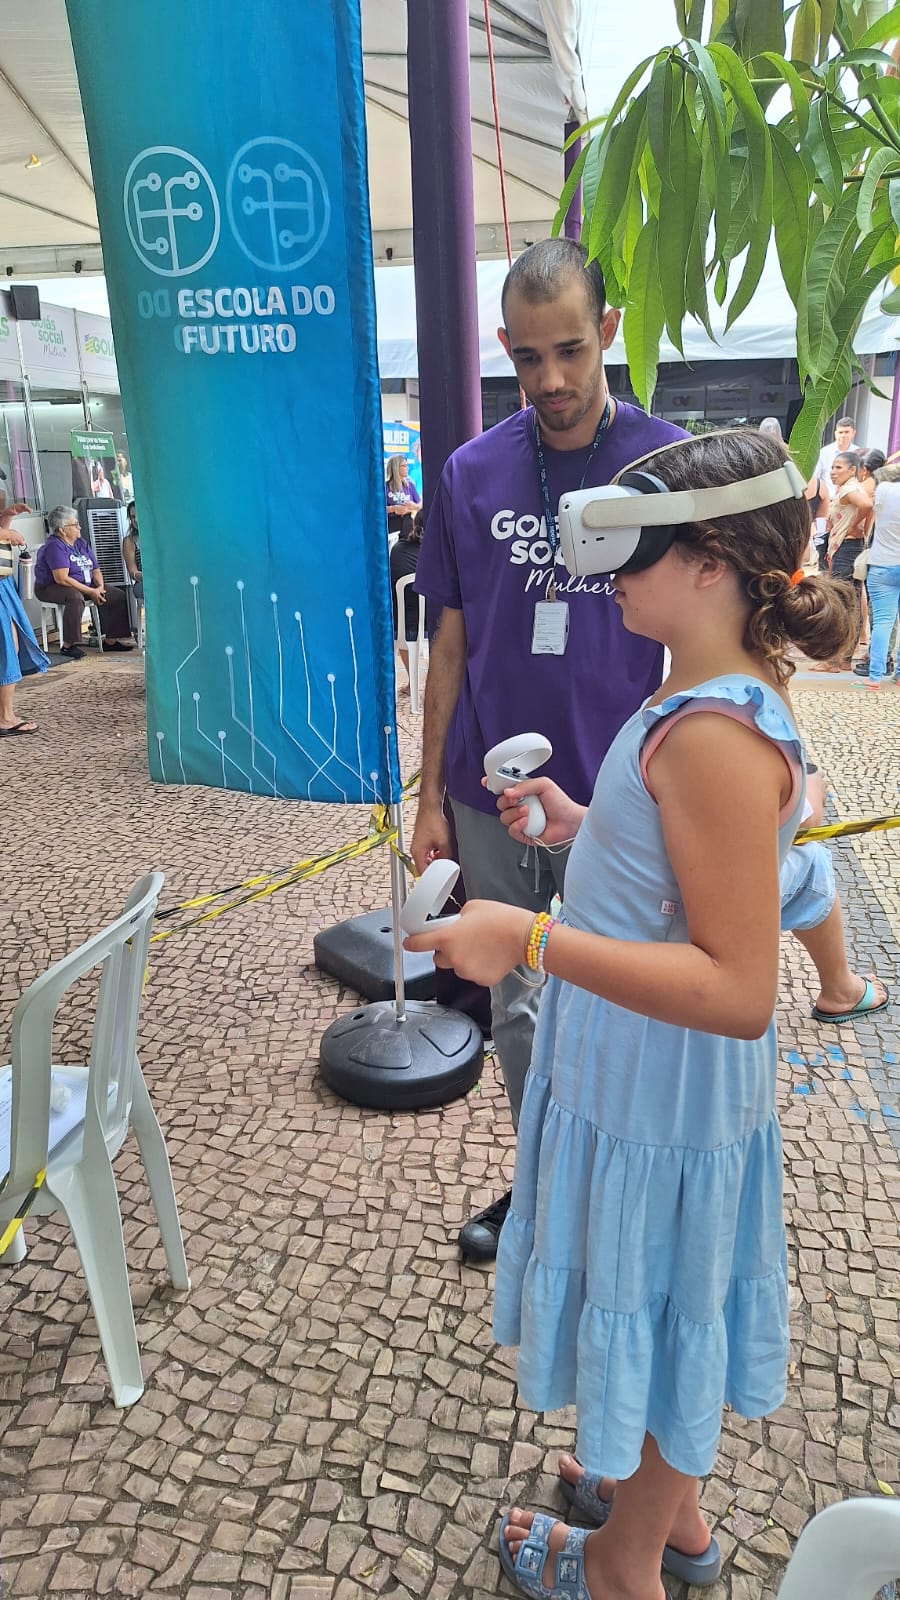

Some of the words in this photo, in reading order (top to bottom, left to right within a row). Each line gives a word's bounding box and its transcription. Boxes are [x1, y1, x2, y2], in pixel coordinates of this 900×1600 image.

[178, 286, 287, 318] ESCOLA
[291, 285, 335, 316] DO
[182, 323, 296, 354] FUTURO
[524, 567, 616, 599] Mulher
